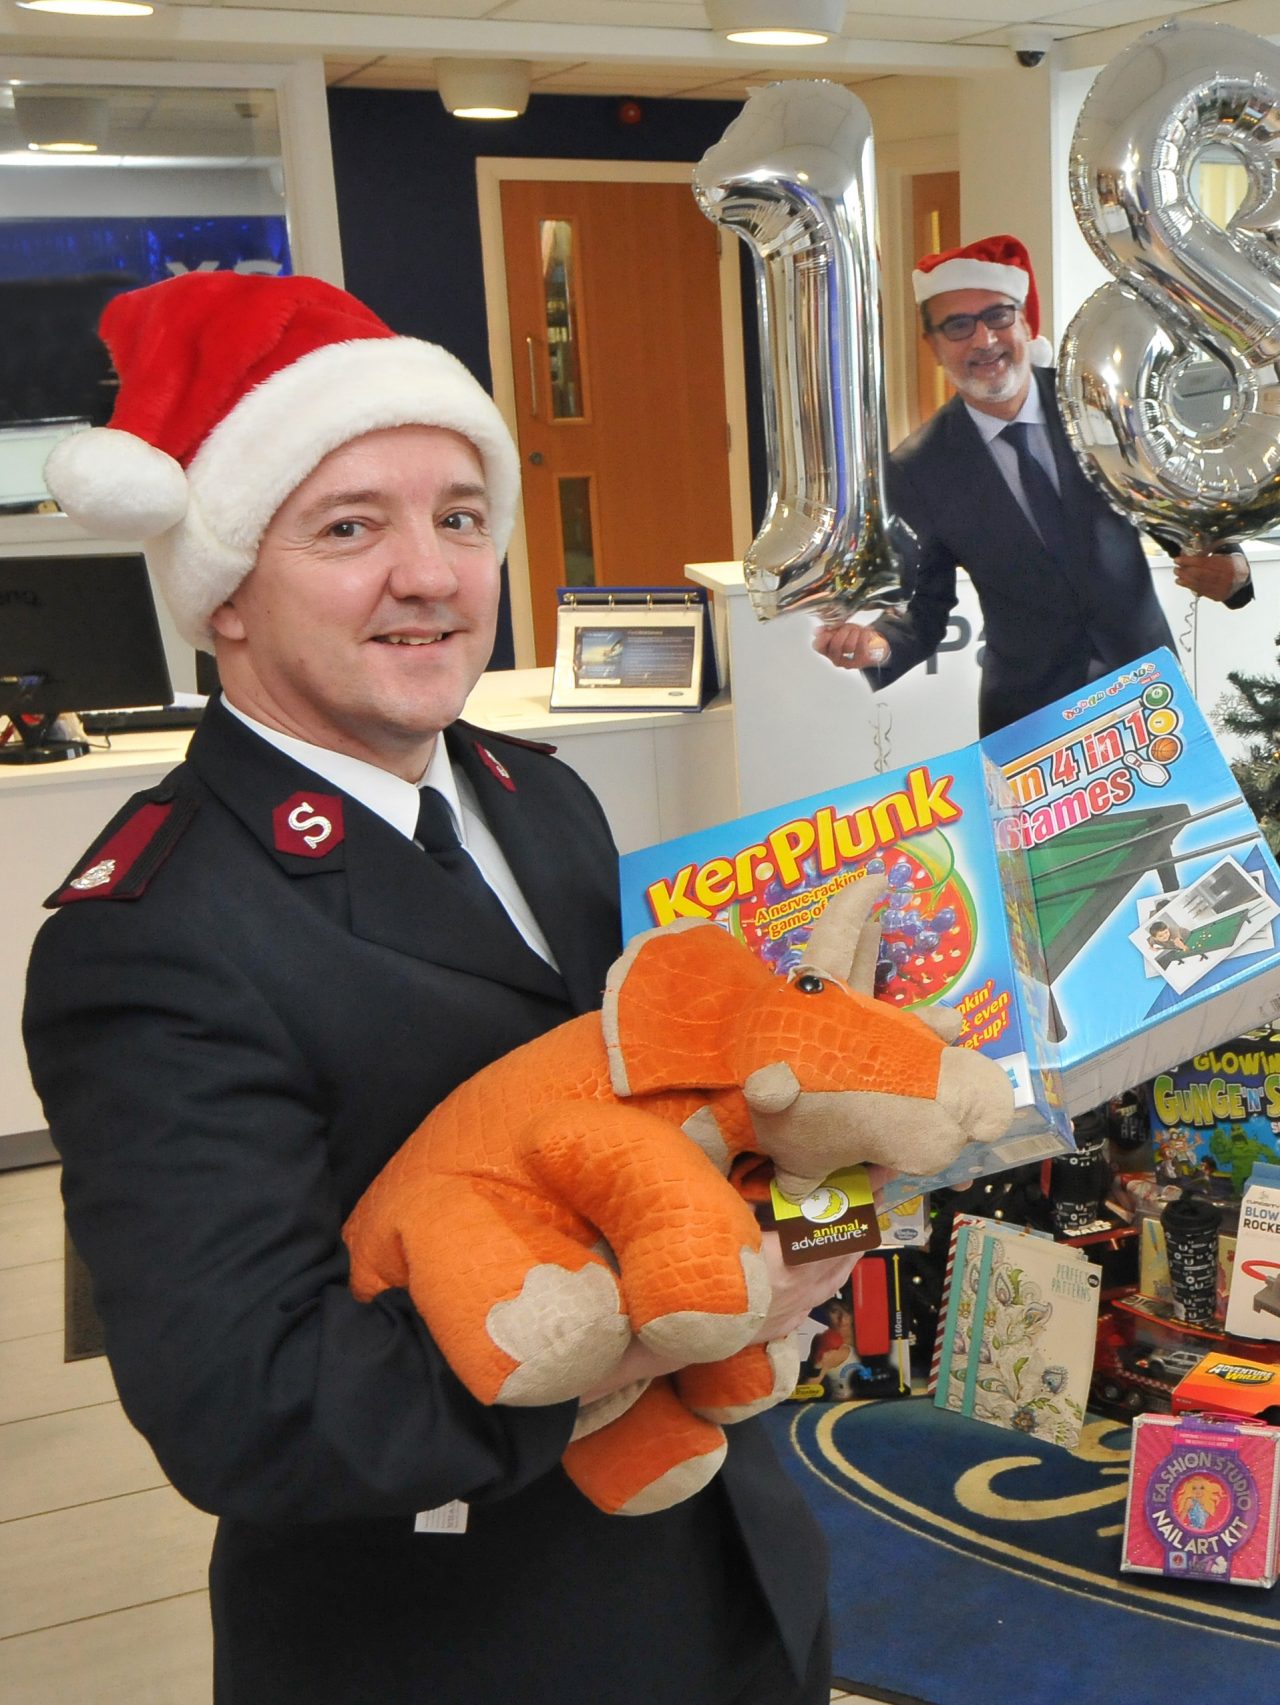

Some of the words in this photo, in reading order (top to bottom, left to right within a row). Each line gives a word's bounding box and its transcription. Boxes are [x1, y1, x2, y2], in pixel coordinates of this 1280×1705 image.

[1051, 745, 1080, 787] 4
[1083, 725, 1125, 773] in
[1124, 707, 1150, 750] 1
[287, 801, 334, 849] S
[754, 908, 769, 926] A
[769, 868, 868, 919] nerve-racking
[769, 909, 811, 939] game
[811, 901, 828, 924] of
[973, 991, 1009, 1026] even
[959, 1010, 1008, 1050] et-up!
[1154, 1074, 1247, 1127] GUNGE
[813, 1219, 860, 1239] animal
[1245, 1206, 1280, 1221] BLOW
[791, 1228, 863, 1251] adventure
[1207, 1363, 1275, 1378] ADVENTURE
[1152, 1451, 1212, 1503] FASHION
[1213, 1456, 1252, 1512] STUDIO
[1151, 1509, 1184, 1550] NAIL
[1184, 1535, 1220, 1555] ART
[1220, 1515, 1249, 1548] KIT
